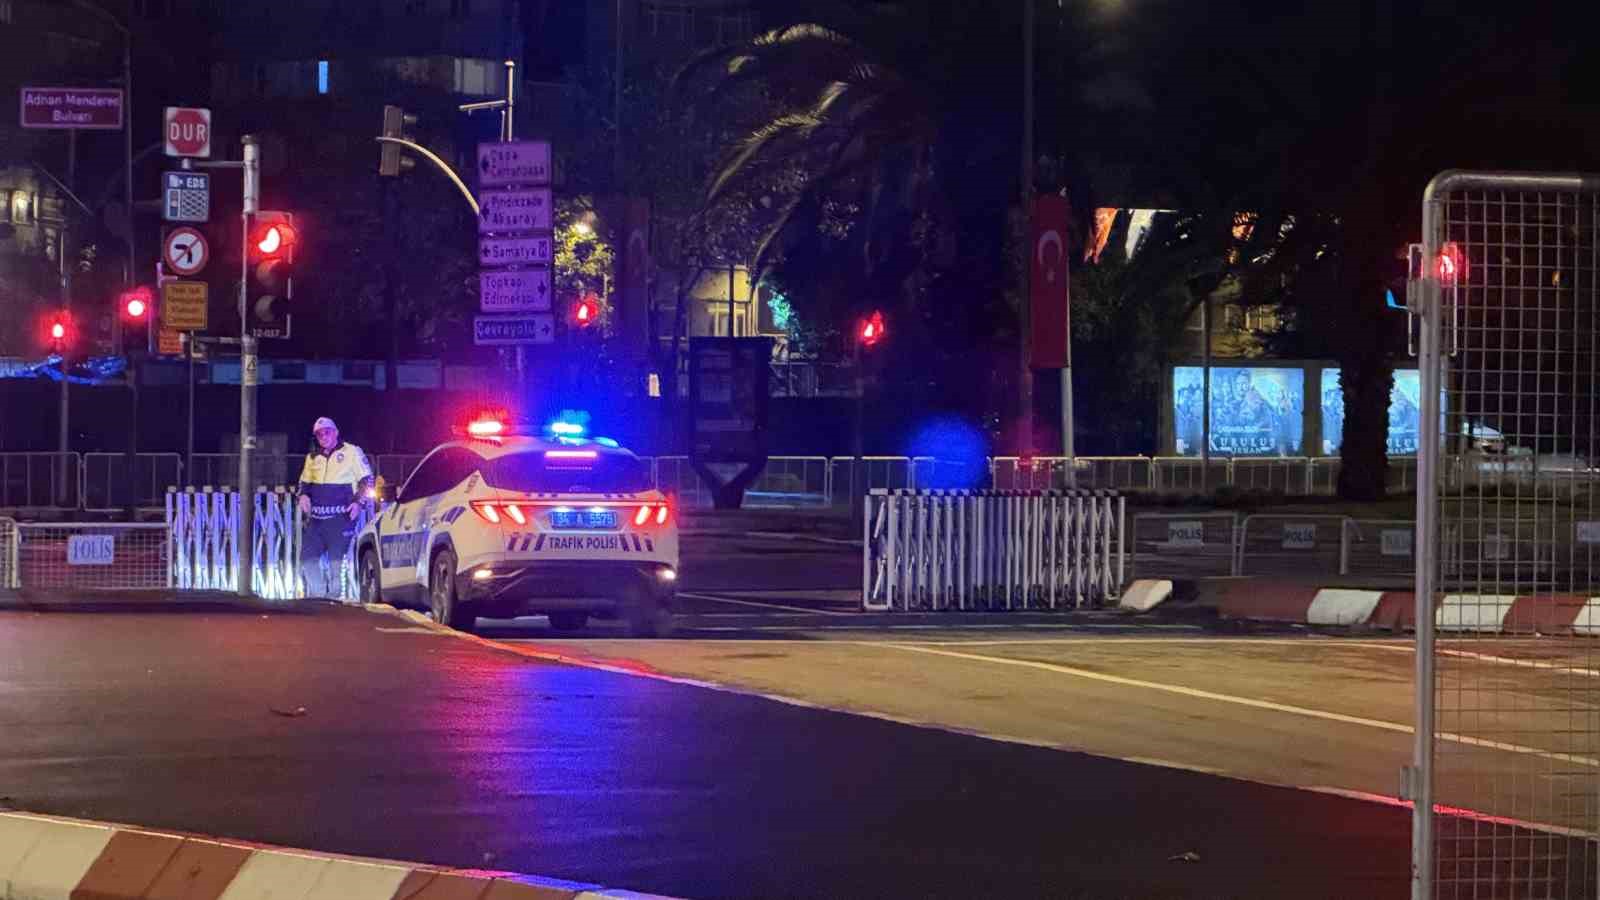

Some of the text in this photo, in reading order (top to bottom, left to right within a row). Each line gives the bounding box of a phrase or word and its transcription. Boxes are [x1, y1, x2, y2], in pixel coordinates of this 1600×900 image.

[26, 93, 62, 105] Adnan
[170, 122, 206, 142] DUR
[186, 177, 205, 189] EDS
[491, 212, 537, 226] Aksaray
[492, 244, 537, 260] Samatya
[549, 535, 584, 549] TRAFİK
